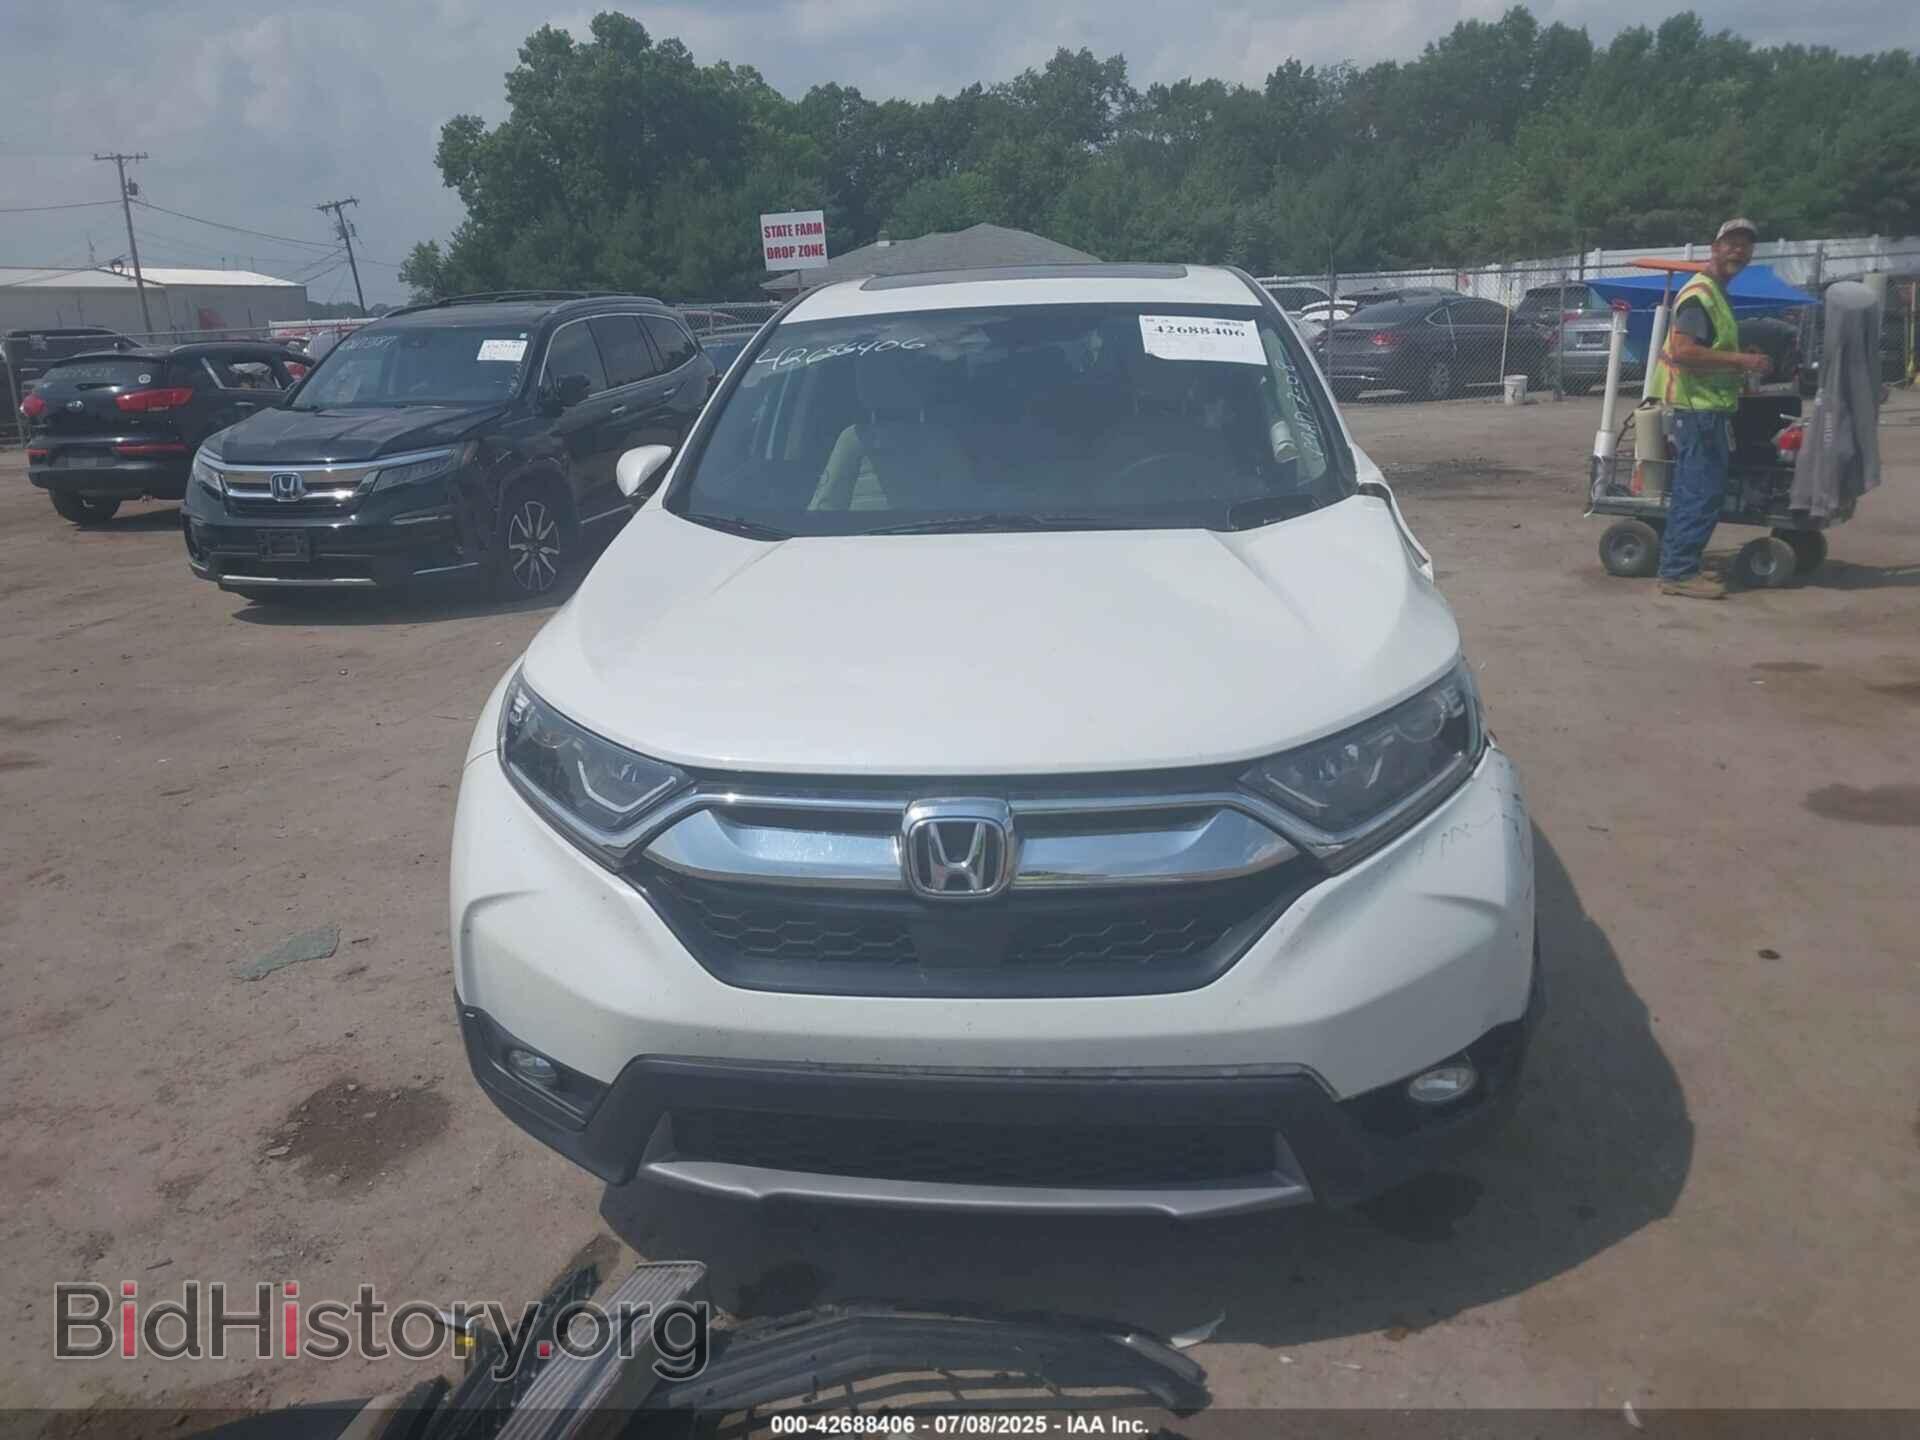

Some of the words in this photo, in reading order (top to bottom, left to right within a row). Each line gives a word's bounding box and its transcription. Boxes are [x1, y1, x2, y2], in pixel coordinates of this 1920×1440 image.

[764, 225, 793, 238] STATE
[795, 223, 822, 236] FARM
[768, 246, 796, 259] DROP
[798, 244, 824, 257] ZONE
[1153, 325, 1246, 337] 42688406
